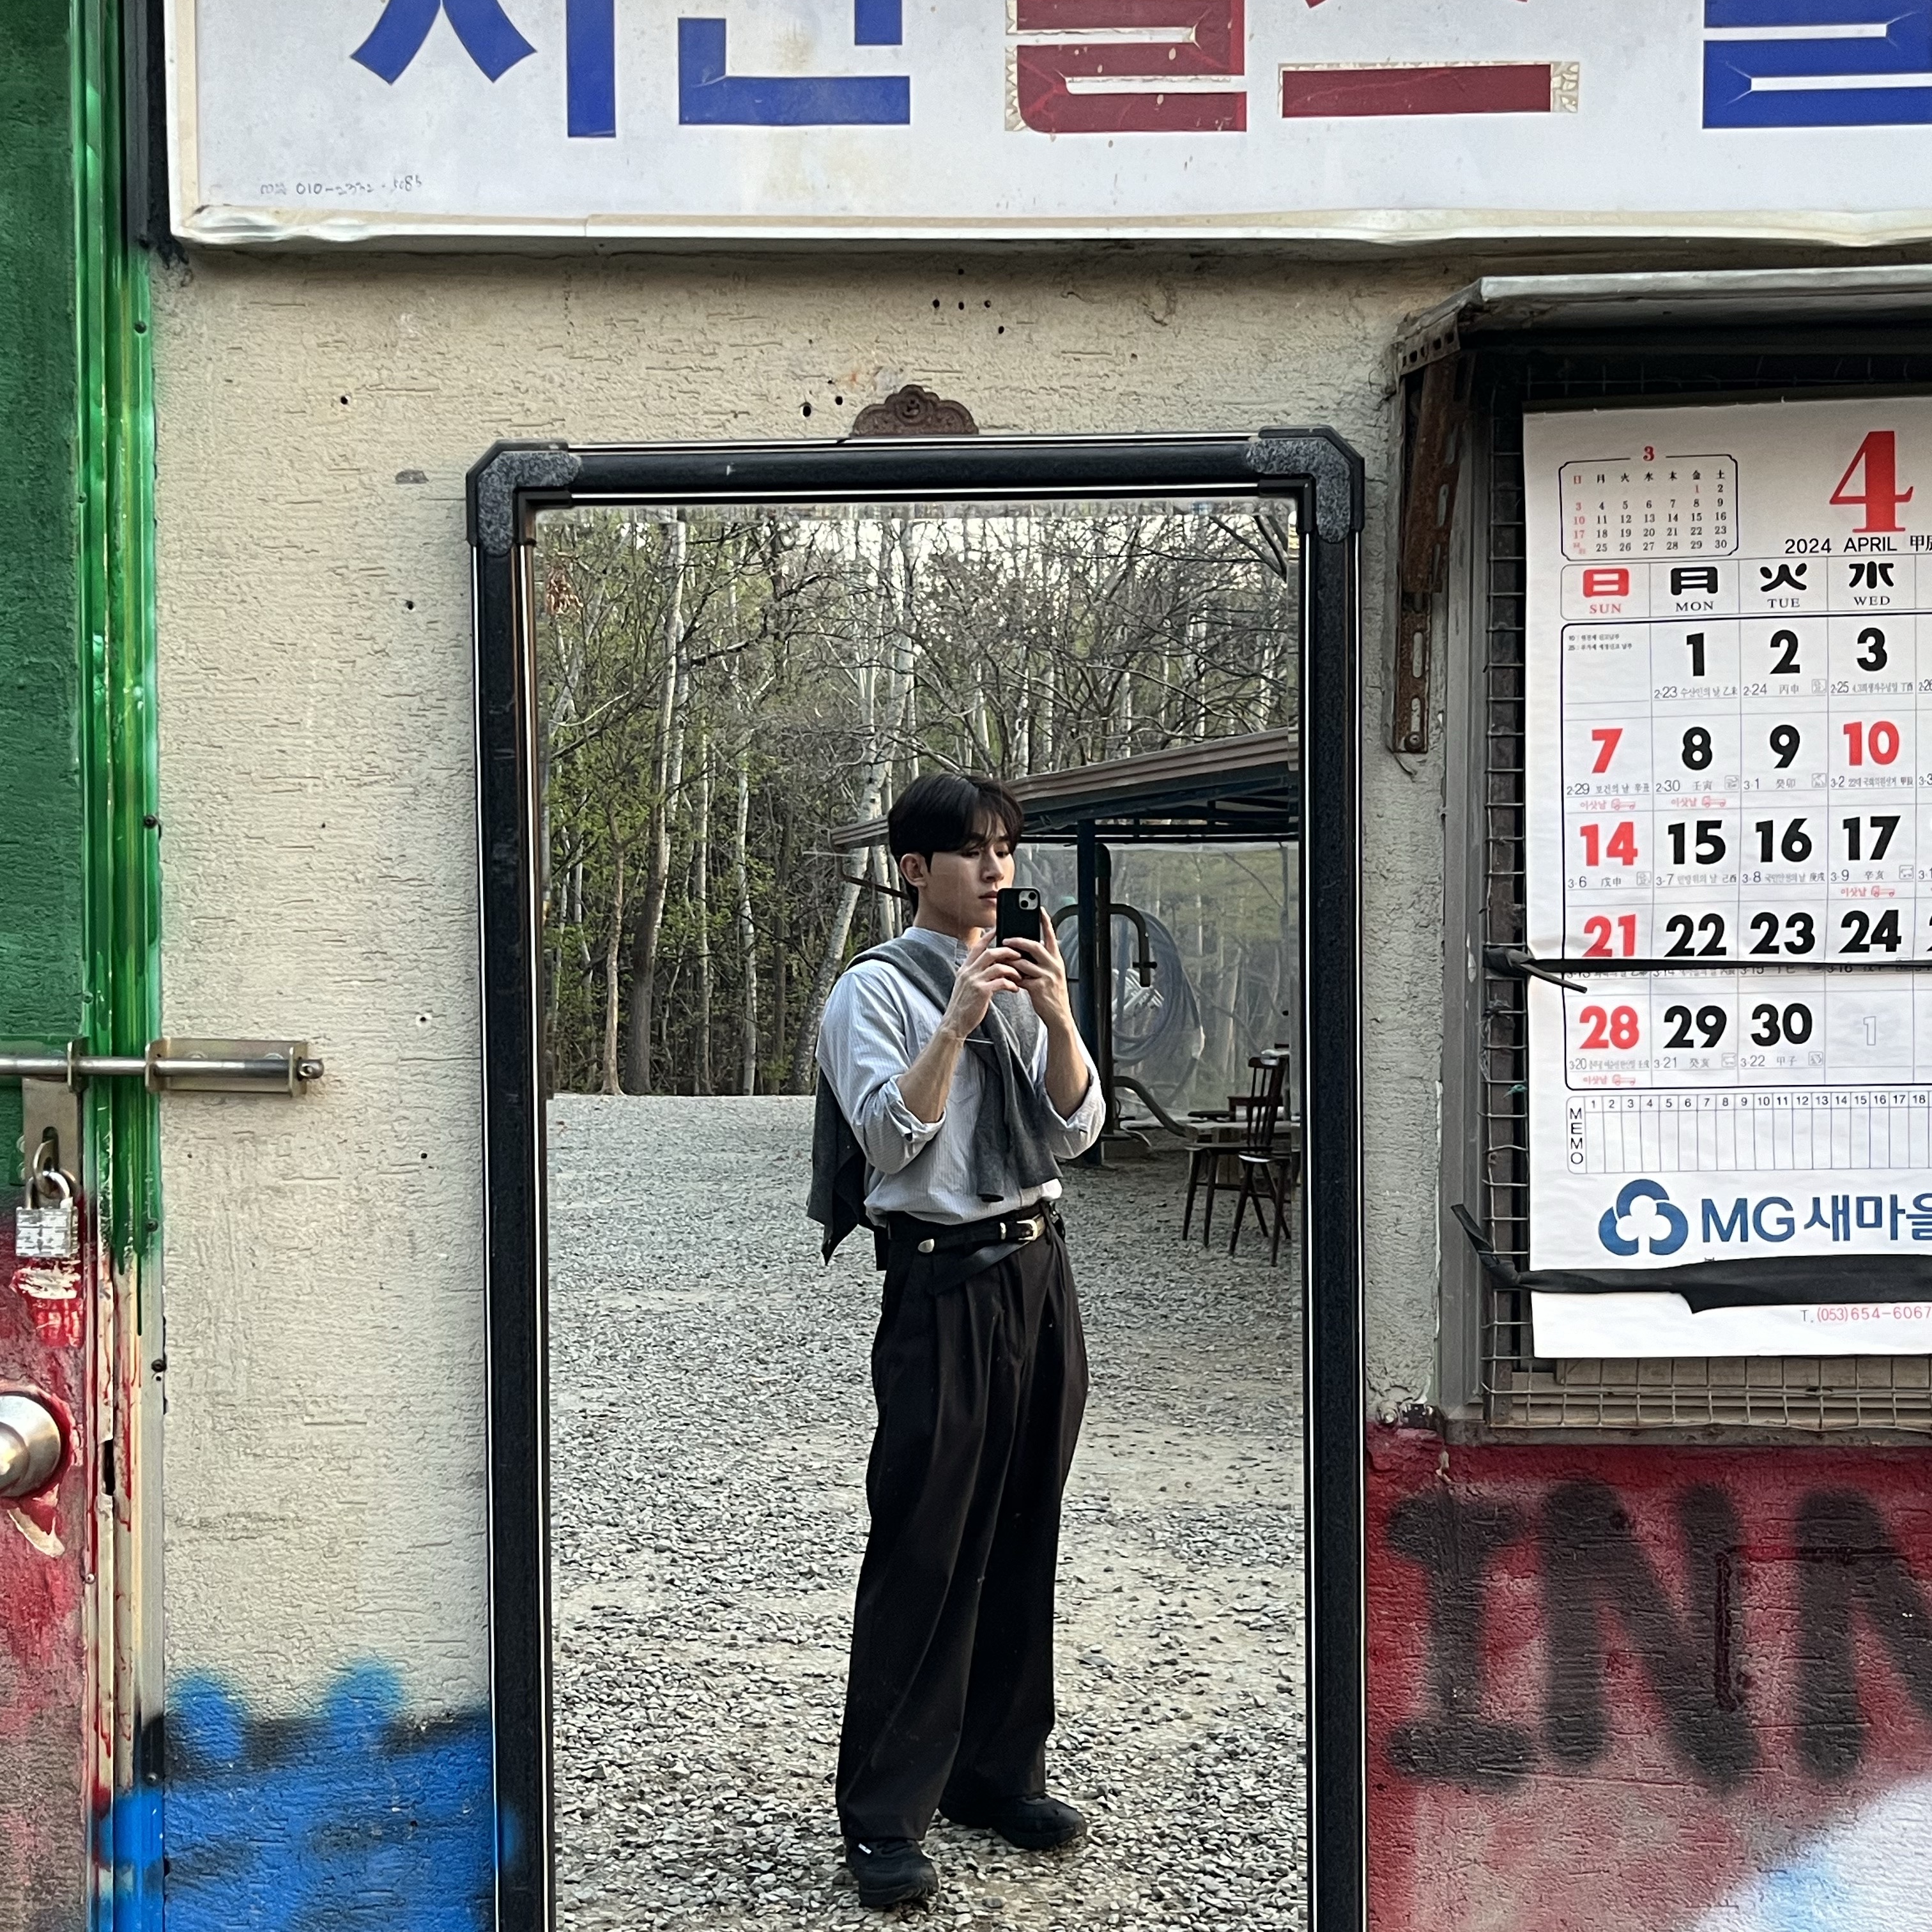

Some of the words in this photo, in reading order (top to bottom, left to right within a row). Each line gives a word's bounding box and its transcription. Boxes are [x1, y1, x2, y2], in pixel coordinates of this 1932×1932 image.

[1643, 445, 1655, 461] 3
[1719, 469, 1724, 479] 土
[1828, 431, 1914, 533] 4
[1717, 484, 1724, 493] 2
[1598, 502, 1604, 510] 4
[1622, 500, 1629, 510] 5
[1646, 500, 1652, 509] 6
[1670, 499, 1676, 509] 7
[1693, 498, 1700, 508] 8
[1717, 498, 1724, 507] 9
[1597, 514, 1607, 525] 11
[1621, 514, 1632, 524] 12
[1644, 513, 1655, 523] 13
[1668, 513, 1678, 523] 14
[1691, 512, 1703, 522] 15
[1715, 511, 1727, 521] 16
[1597, 529, 1608, 539] 18
[1621, 528, 1632, 538] 19
[1643, 528, 1655, 537] 20
[1666, 527, 1678, 537] 21
[1690, 526, 1703, 536] 22
[1714, 525, 1727, 535] 23
[1596, 543, 1608, 553] 25
[1619, 542, 1632, 552] 26
[1643, 541, 1655, 551] 27
[1666, 541, 1678, 551] 28
[1690, 540, 1703, 549] 29
[1714, 539, 1728, 549] 30
[1784, 537, 1832, 555] 2024
[1843, 536, 1897, 553] APRIL
[1583, 568, 1630, 598] 日
[1670, 566, 1719, 596] 月
[1759, 562, 1807, 592] 火
[1848, 561, 1894, 589] 水
[1589, 603, 1621, 614] SUN
[1675, 601, 1713, 612] MON
[1767, 598, 1800, 608] TUE
[1853, 595, 1890, 606] WED
[1686, 632, 1705, 677] 1
[1770, 629, 1800, 675] 2
[1857, 627, 1888, 672] 3
[1591, 728, 1623, 774] 7
[1681, 726, 1713, 771] 8
[1769, 724, 1800, 769] 9
[1843, 721, 1900, 766] 10
[1581, 801, 1607, 810] 이삿날
[1671, 797, 1697, 808] 이삿날
[1579, 821, 1639, 867] 14
[1667, 820, 1726, 865] 15
[1755, 818, 1813, 863] 16
[1843, 815, 1901, 861] 17
[1841, 887, 1866, 897] 이삿날
[1582, 914, 1636, 958] 21
[1664, 913, 1727, 958] 22
[1749, 912, 1816, 955] 23
[1838, 909, 1902, 954] 24
[1579, 1005, 1640, 1050] 28
[1663, 1005, 1728, 1049] 29
[1750, 1002, 1813, 1047] 30
[1863, 1015, 1877, 1046] 1
[1591, 1100, 1595, 1109] 1
[1608, 1099, 1615, 1109] 2
[1627, 1098, 1634, 1108] 3
[1646, 1098, 1653, 1108] 4
[1665, 1098, 1673, 1108] 5
[1684, 1098, 1692, 1108] 6
[1704, 1098, 1710, 1107] 7
[1722, 1097, 1729, 1107] 8
[1740, 1097, 1748, 1107] 9
[1758, 1096, 1770, 1106] 10
[1776, 1096, 1788, 1106] 11
[1796, 1096, 1809, 1106] 12
[1816, 1095, 1829, 1105] 13
[1835, 1095, 1848, 1105] 14
[1854, 1095, 1867, 1105] 15
[1874, 1094, 1887, 1105] 16
[1893, 1094, 1906, 1104] 17
[1912, 1094, 1926, 1104] 18
[1570, 1108, 1583, 1165] MEMO
[1701, 1196, 1795, 1243] MG
